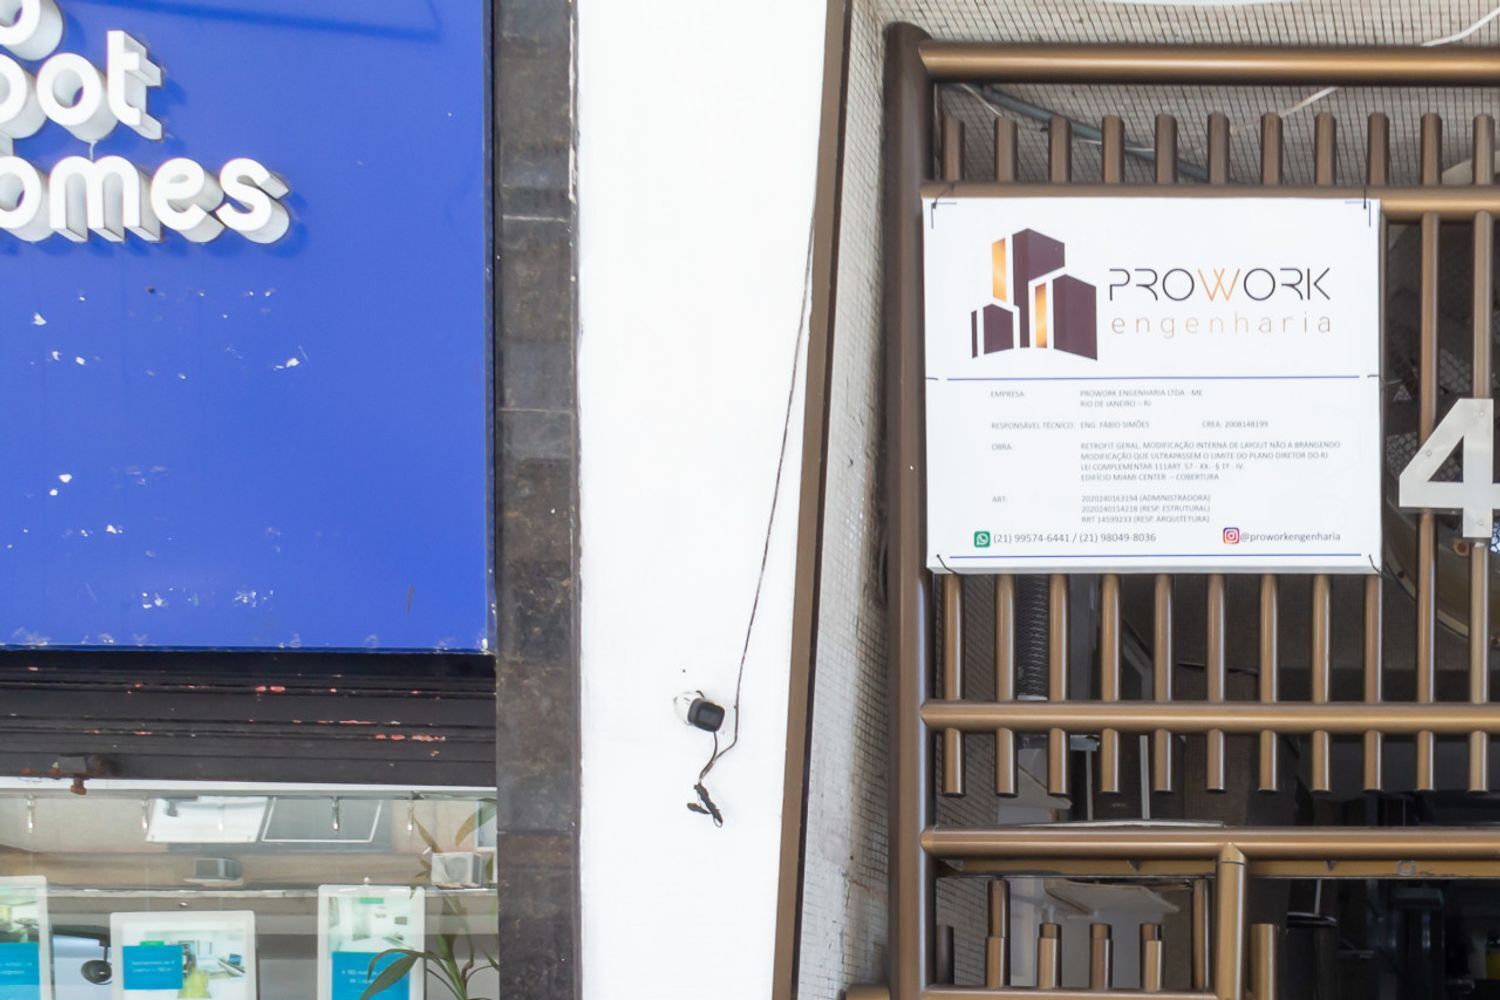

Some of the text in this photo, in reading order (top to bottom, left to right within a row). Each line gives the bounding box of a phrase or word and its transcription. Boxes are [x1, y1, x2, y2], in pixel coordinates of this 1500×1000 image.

[1109, 267, 1331, 302] PROWORK
[1111, 311, 1332, 339] engenharia
[1079, 389, 1117, 397] PROWORK
[1118, 389, 1166, 397] ENGENHARIA
[1079, 400, 1093, 408] RIO
[1095, 400, 1103, 408] DE
[1106, 400, 1136, 408] JANEIRO
[1142, 440, 1194, 450] MODIFICAÇÃO
[1229, 441, 1238, 449] DE
[1240, 441, 1267, 449] LAYOUT
[1269, 440, 1286, 449] NÃO
[1080, 451, 1132, 461] MODIFICAÇÃO
[1133, 452, 1149, 460] QUE
[1249, 451, 1274, 459] PLANO
[1307, 451, 1319, 459] DO
[1112, 473, 1137, 481] MIAMI
[993, 533, 1012, 544] (21)
[1014, 533, 1070, 543] 99574-6441
[1079, 533, 1098, 544] (21)
[1100, 532, 1157, 543] 98049-8036
[1240, 531, 1341, 543] @proworkengenharia
